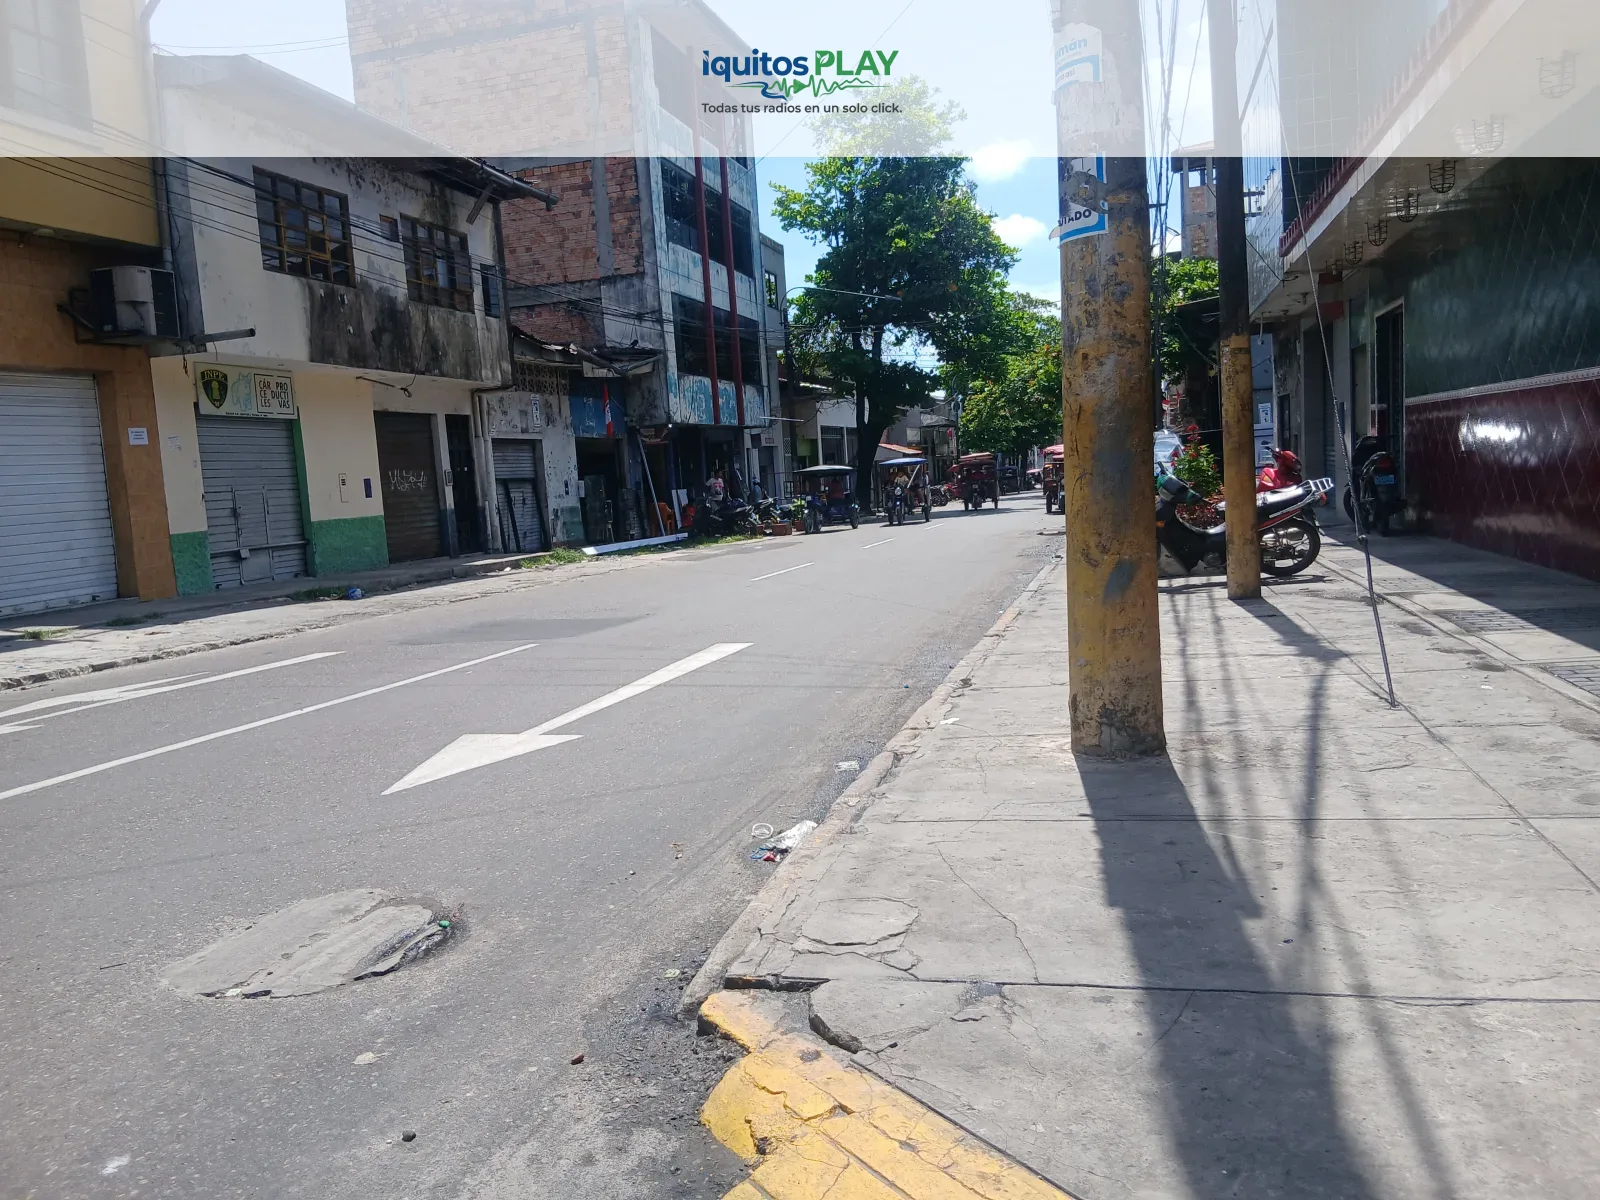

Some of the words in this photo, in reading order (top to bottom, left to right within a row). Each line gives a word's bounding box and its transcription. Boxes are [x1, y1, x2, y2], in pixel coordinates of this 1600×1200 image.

[275, 381, 288, 391] PRO
[259, 390, 267, 399] CE
[270, 390, 289, 399] DUCTI
[260, 399, 271, 408] LES
[278, 400, 290, 409] VAS
